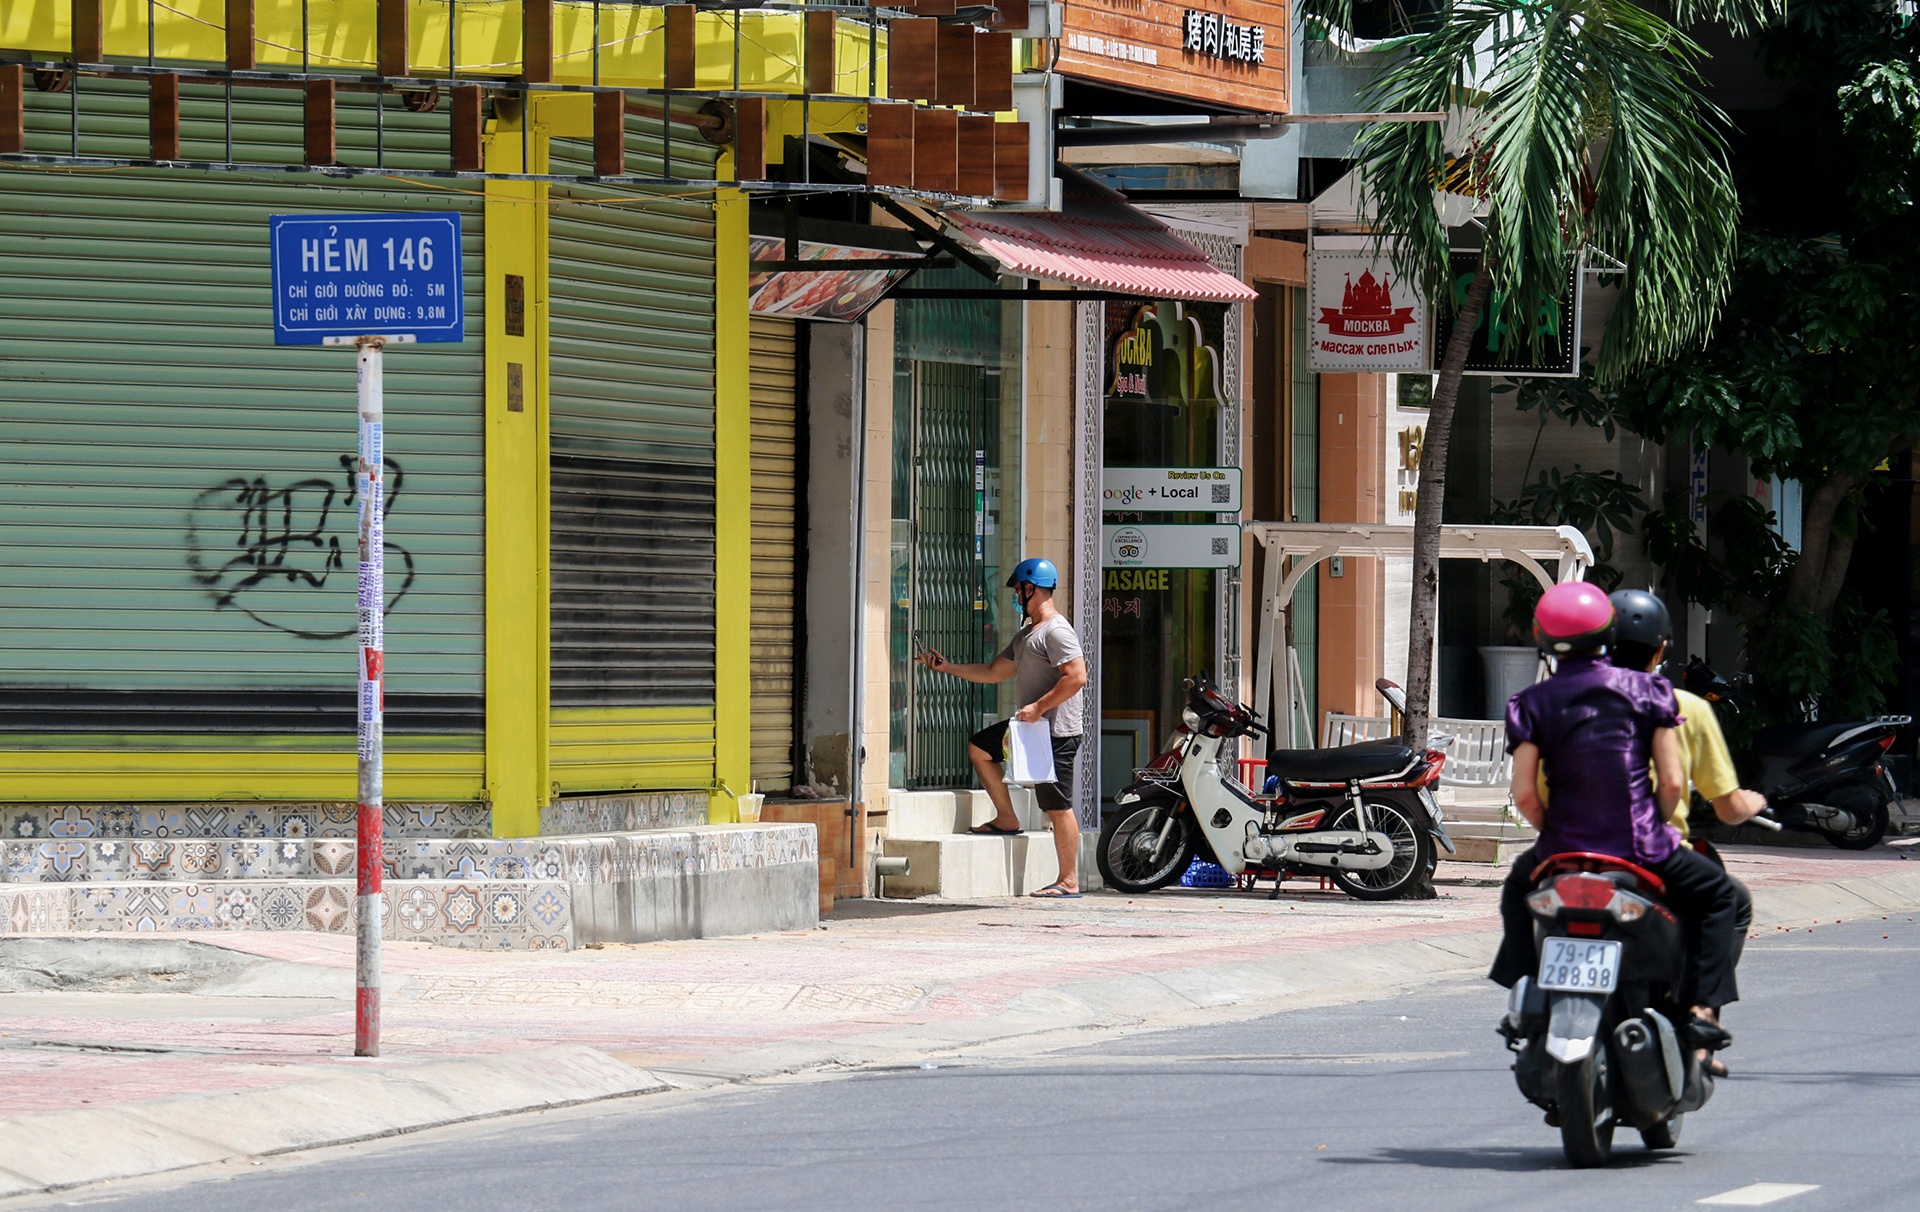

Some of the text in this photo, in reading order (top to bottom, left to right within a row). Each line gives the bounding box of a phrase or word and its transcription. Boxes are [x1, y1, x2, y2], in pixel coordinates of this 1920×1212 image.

[1187, 9, 1265, 63] 烤肉/私房菜
[301, 225, 434, 272] HẺM 146
[289, 281, 308, 299] CHỈ
[315, 281, 338, 298] GIỚI
[344, 280, 384, 298] ĐƯỜNG
[427, 283, 445, 297] 5M
[289, 303, 309, 321] CHỈ
[315, 303, 338, 321] GIỚI
[346, 303, 367, 320] XÂY
[417, 306, 445, 321] 9,8M
[1343, 319, 1391, 332] МОСКВА
[1320, 340, 1365, 356] массаж
[1167, 470, 1226, 480] Review Us On
[1103, 485, 1199, 505] oogle + Local
[1102, 569, 1169, 590] ASAGE
[1102, 597, 1141, 618] 사지
[1554, 942, 1605, 964] 79-C1
[1544, 964, 1611, 988] 288.98
